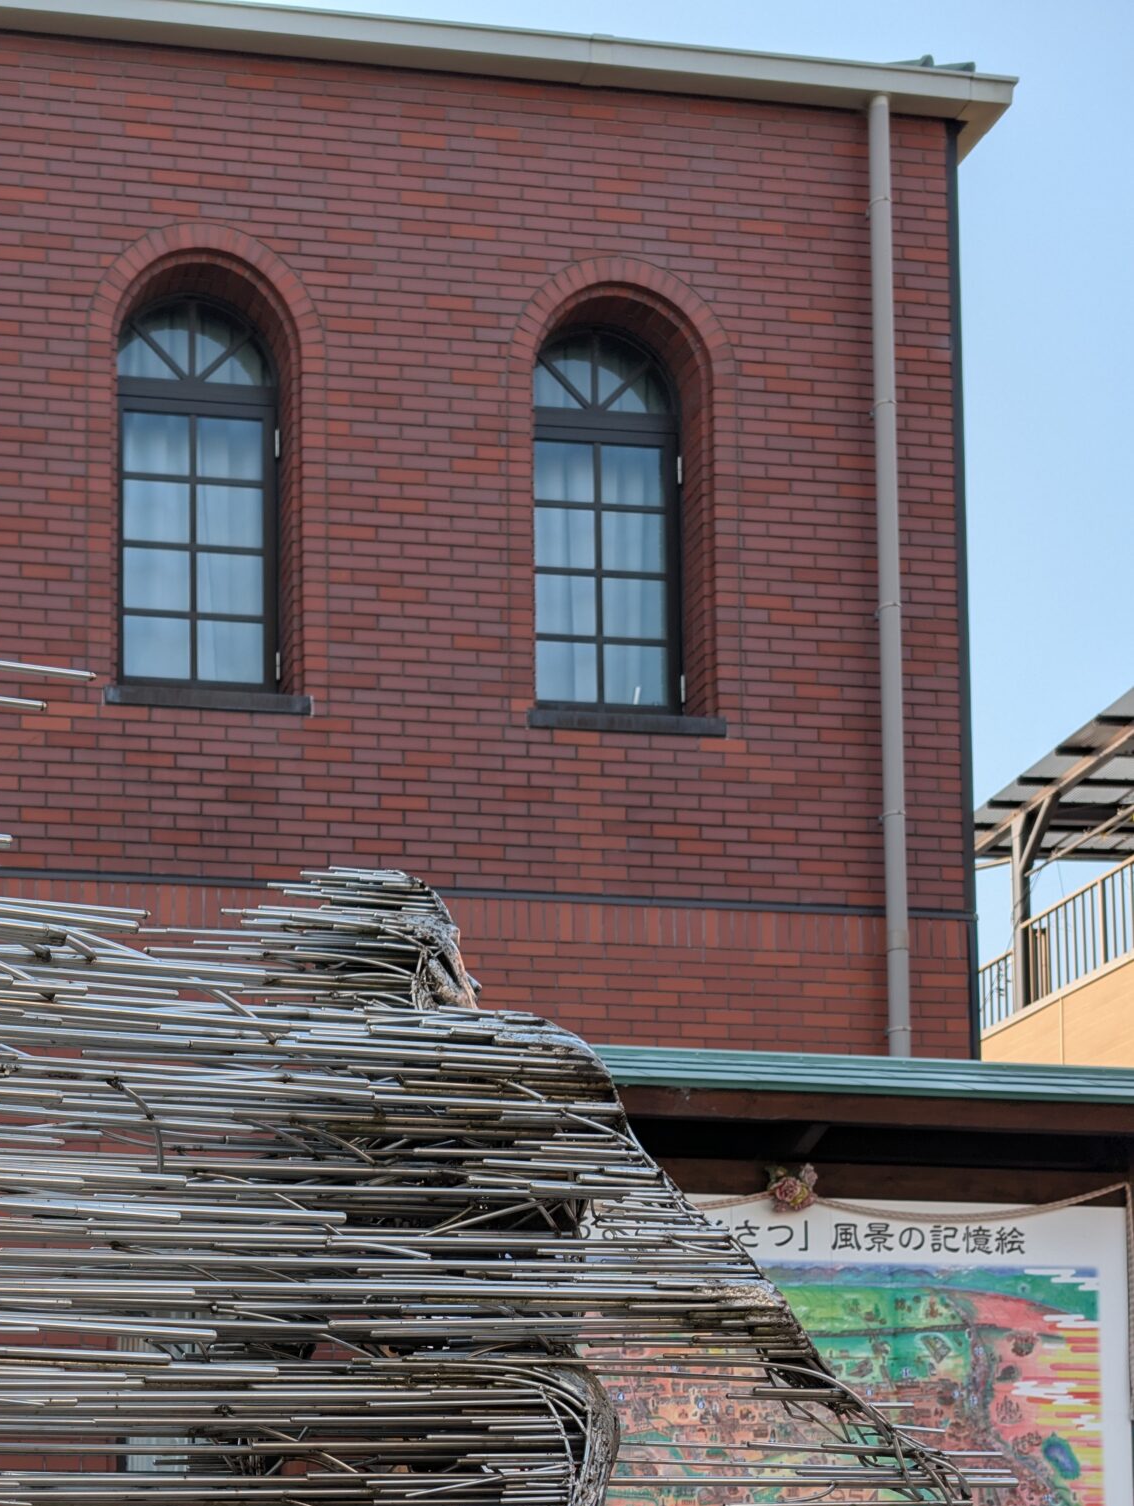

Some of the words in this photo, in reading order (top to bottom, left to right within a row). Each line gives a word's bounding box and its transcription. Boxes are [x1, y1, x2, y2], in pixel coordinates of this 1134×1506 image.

[716, 1220, 1026, 1255] さつ」風景の記憶絵
